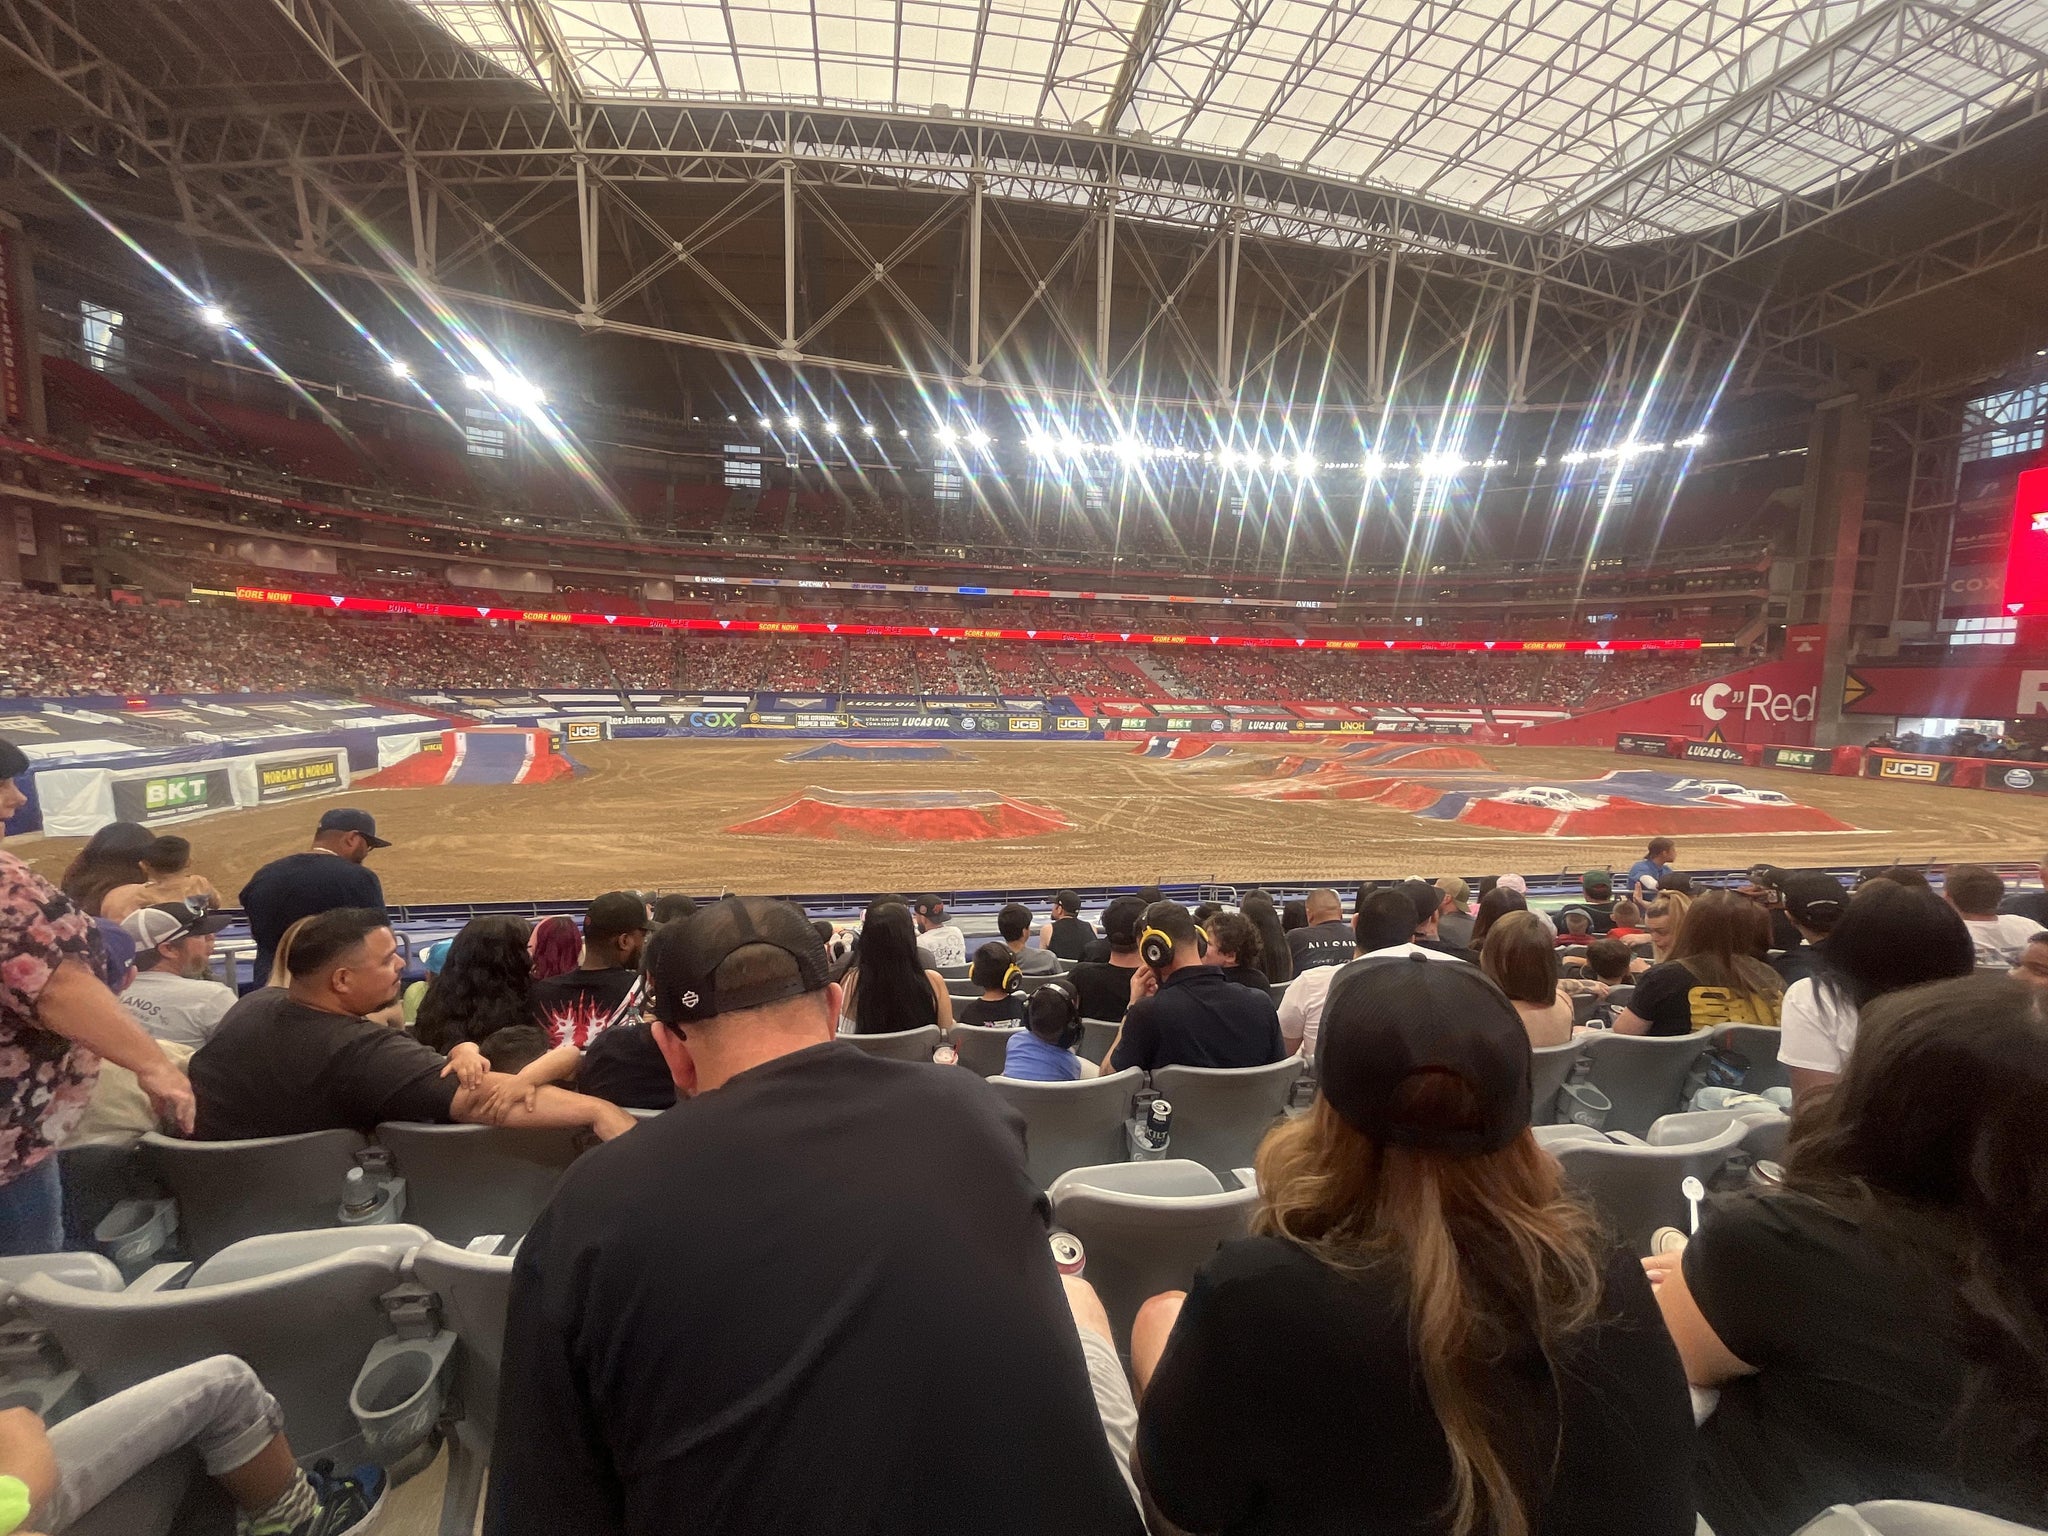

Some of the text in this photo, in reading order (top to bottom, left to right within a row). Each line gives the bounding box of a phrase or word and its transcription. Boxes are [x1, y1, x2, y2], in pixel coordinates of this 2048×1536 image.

[798, 580, 824, 588] SAFEWAY
[1951, 576, 2001, 593] COX
[267, 592, 293, 602] NOW!
[522, 612, 572, 622] SCORE NOW!
[757, 622, 799, 632] SCORE NOW!
[963, 629, 1002, 638] SCORE NOW!
[1522, 641, 1566, 650] SCORE NOW!
[1745, 684, 1817, 722] Red
[690, 712, 737, 728] COX
[902, 717, 950, 727] LUCAS OIL
[1011, 720, 1040, 729] JCB
[1059, 719, 1087, 729] JCB
[1121, 719, 1147, 728] BKT
[1167, 719, 1192, 728] BKT
[1248, 721, 1289, 731] LUCAS OIL
[1340, 721, 1365, 730] UNOH
[571, 728, 597, 737] JCB
[1687, 745, 1722, 758] LUCAS
[1779, 749, 1815, 763] BKT
[263, 762, 334, 786] MORGAN & MORGAN
[1886, 762, 1933, 777] JCB
[148, 779, 206, 804] BKT
[121, 996, 162, 1016] ANDS
